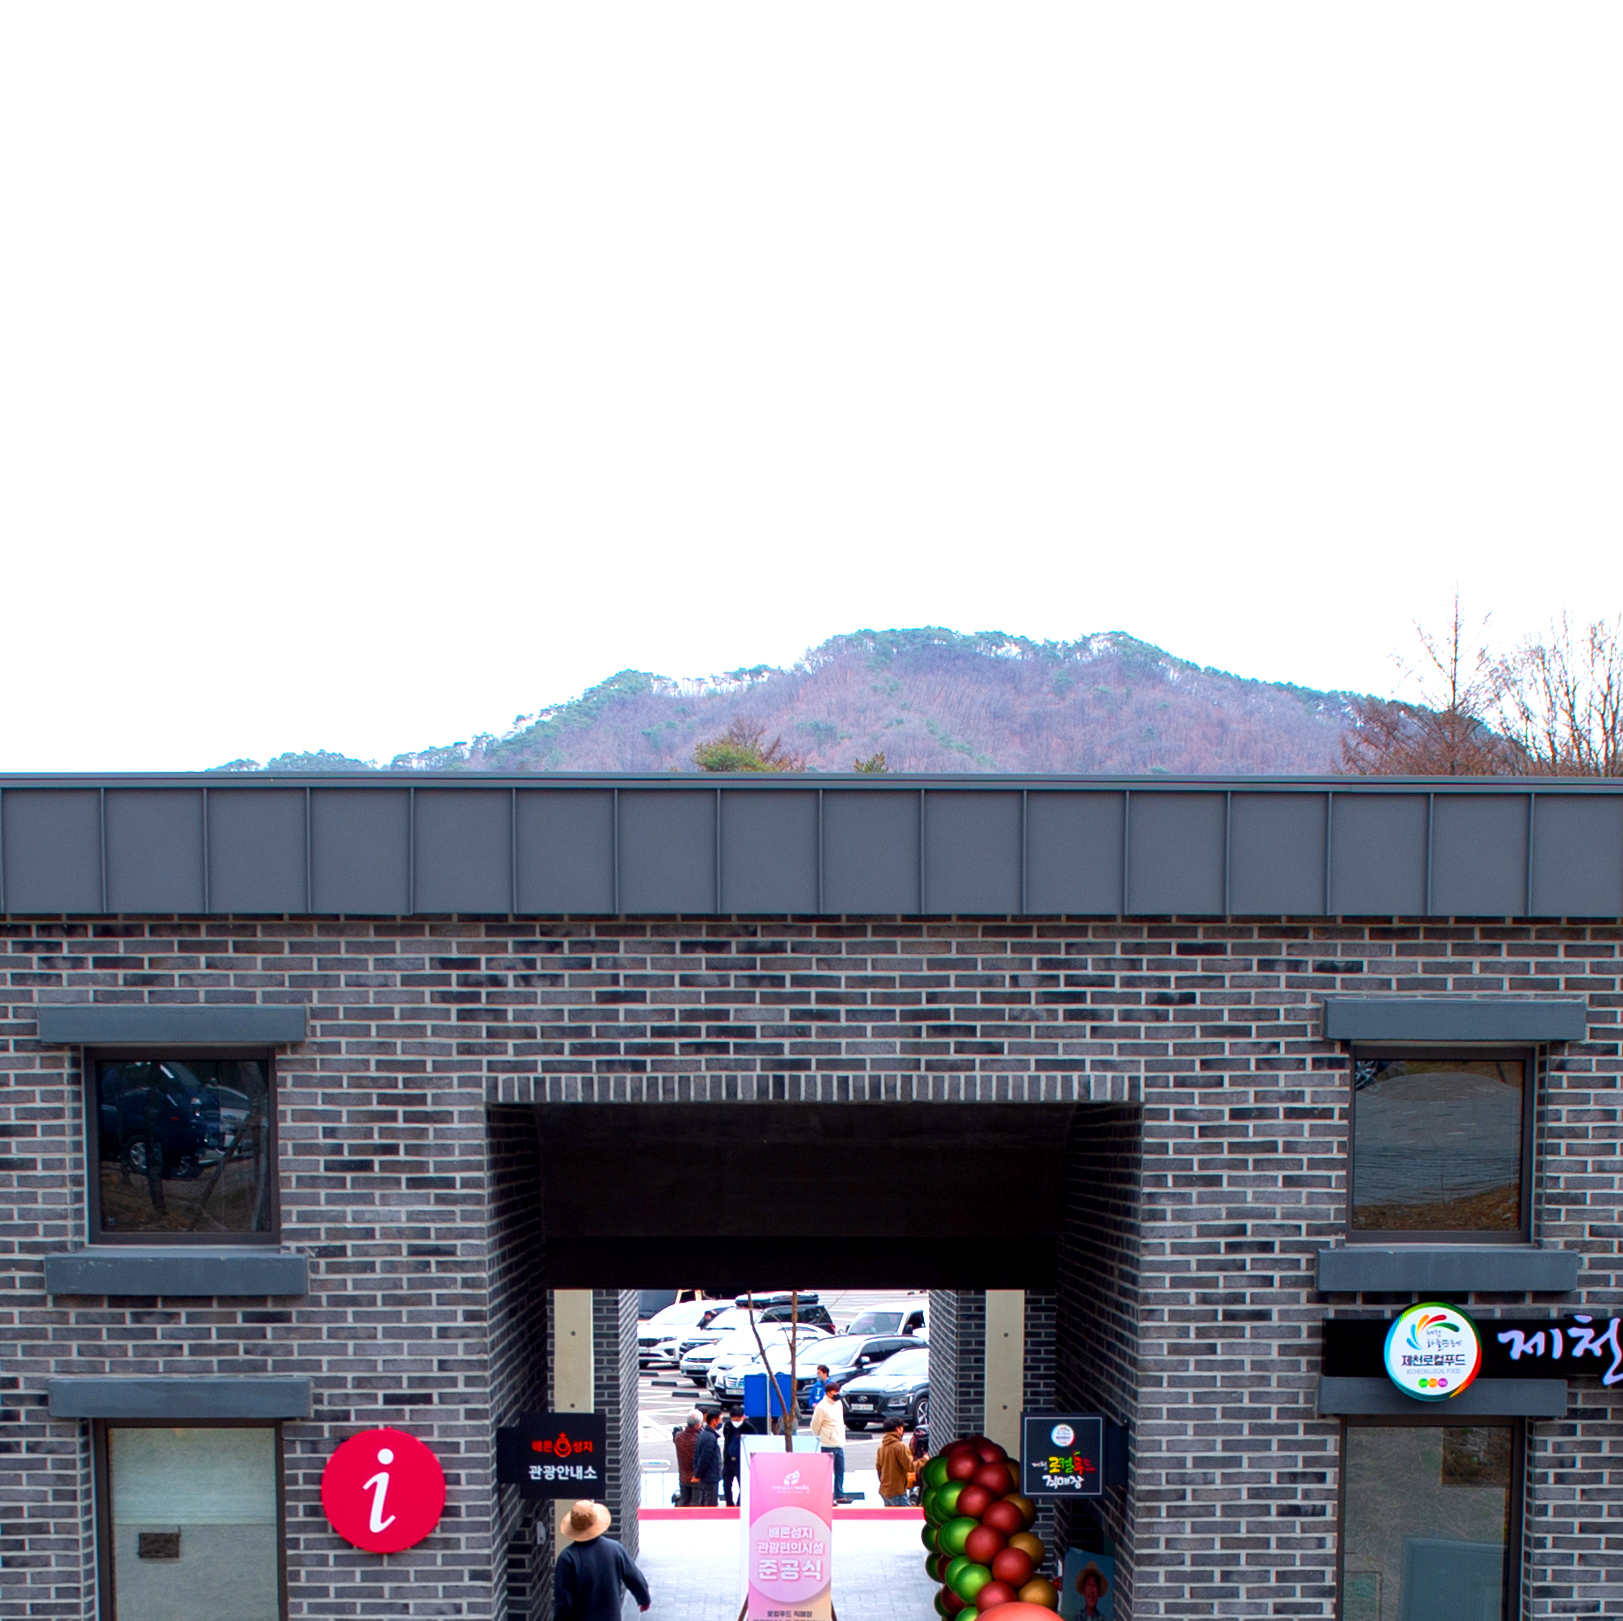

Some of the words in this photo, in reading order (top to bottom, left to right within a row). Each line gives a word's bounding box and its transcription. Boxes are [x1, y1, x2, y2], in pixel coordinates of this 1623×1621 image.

[1401, 1354, 1467, 1367] 제천로컬푸드
[528, 1464, 599, 1481] 관광안내소
[1048, 1455, 1096, 1476] 로컬푸드
[1041, 1474, 1085, 1490] 직매장
[768, 1526, 814, 1539] 배론성지
[757, 1541, 825, 1555] 관광편의시설
[758, 1559, 824, 1581] 준공식
